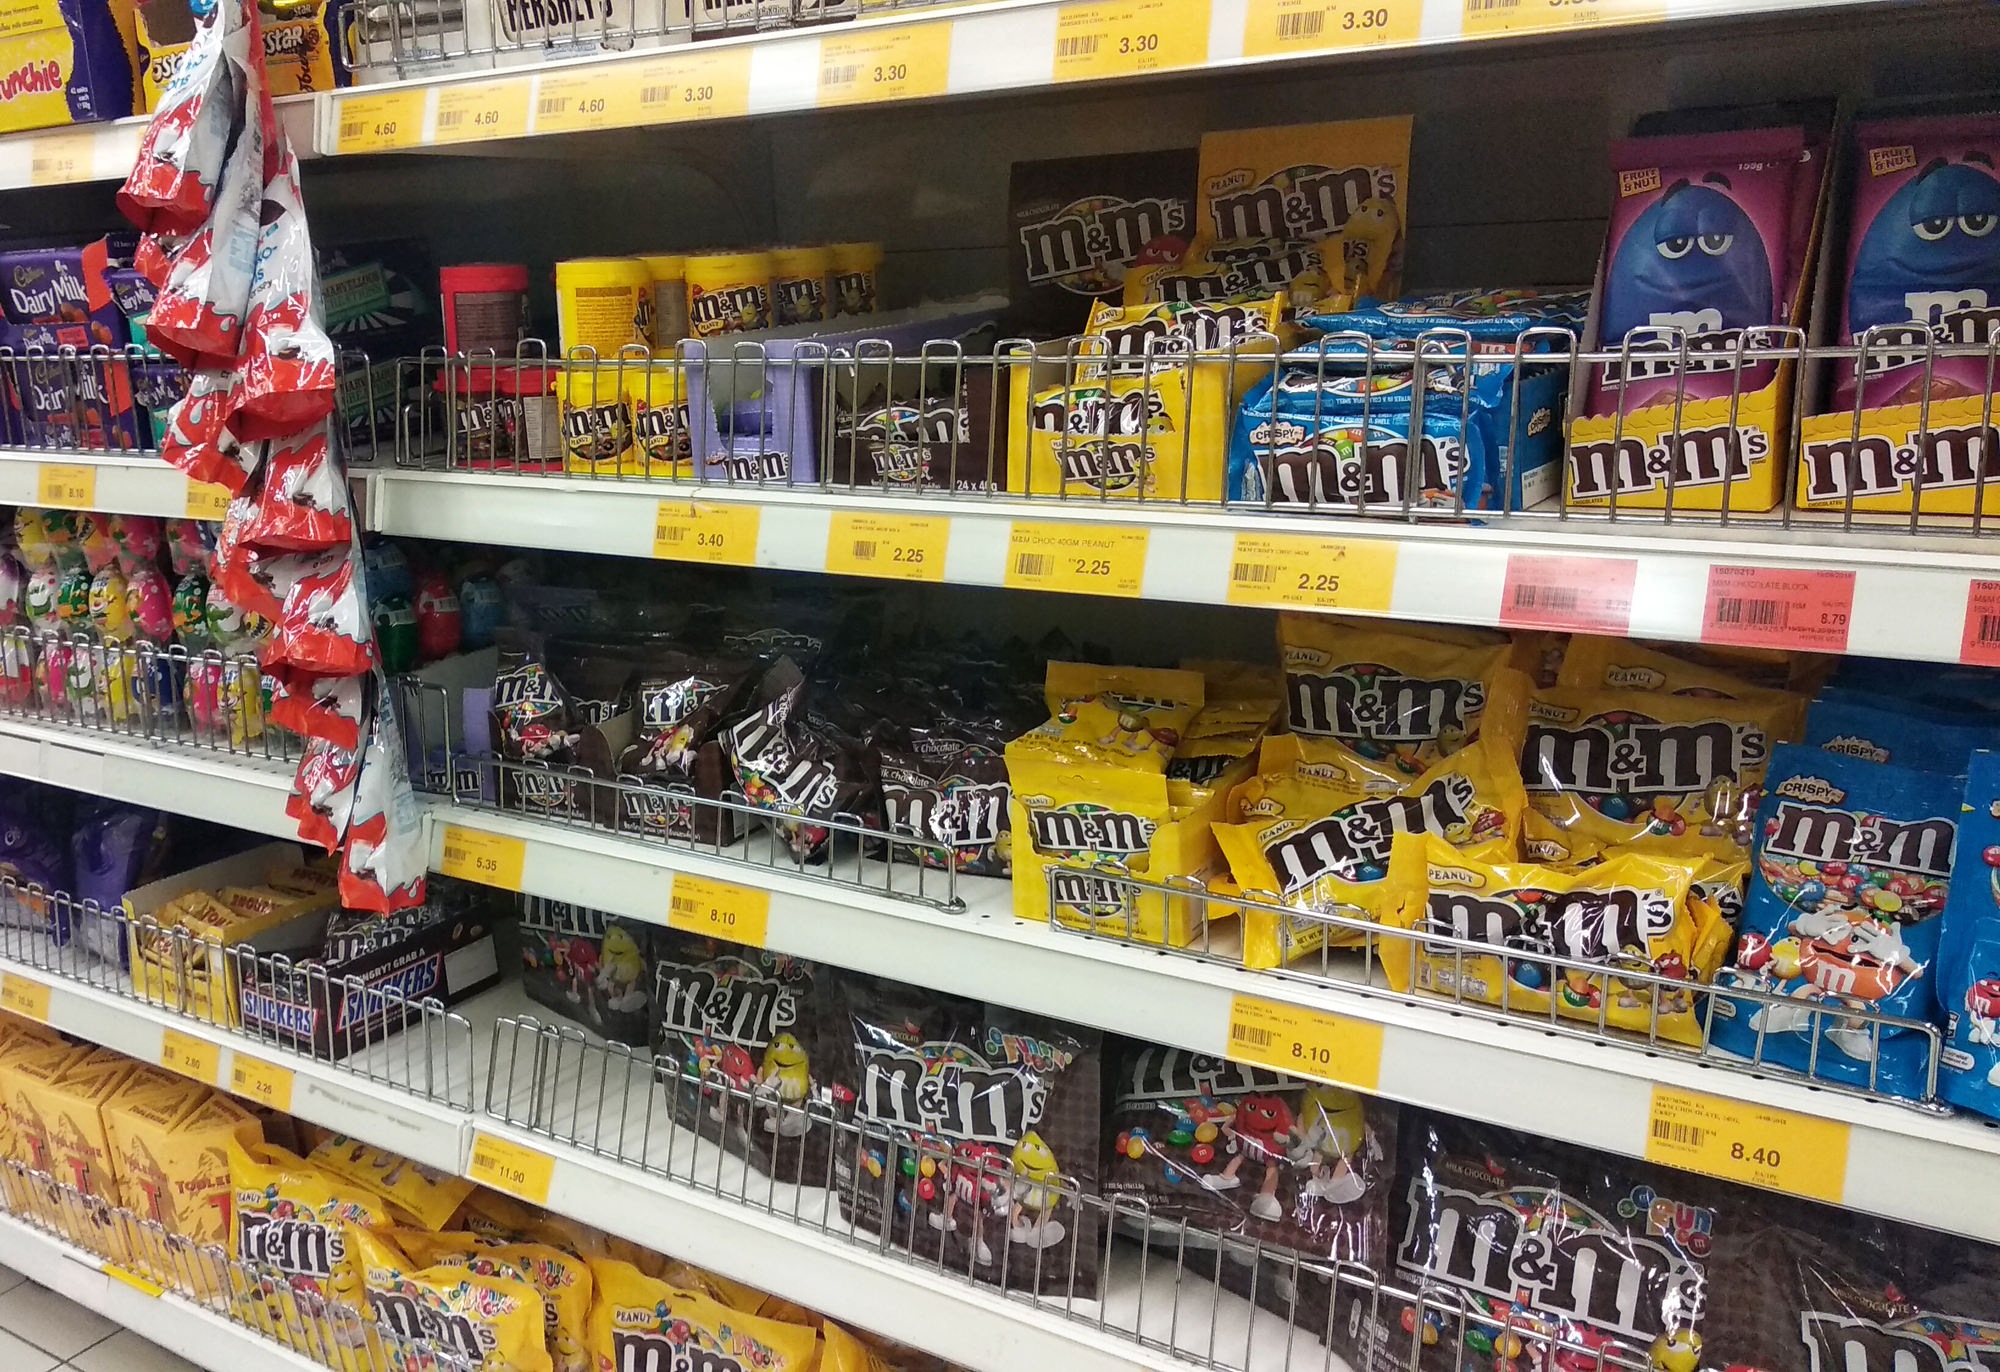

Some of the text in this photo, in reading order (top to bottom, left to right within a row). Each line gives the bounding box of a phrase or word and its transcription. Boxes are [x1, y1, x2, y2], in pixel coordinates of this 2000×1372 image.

[509, 0, 613, 32] HERSHEYS
[1342, 8, 1388, 31] 3.30
[1119, 33, 1158, 54] 3.30
[0, 60, 62, 101] unchie
[873, 63, 907, 83] 3.30
[684, 85, 713, 102] 3.30
[578, 98, 605, 114] 4.60
[474, 110, 499, 126] 4.60
[374, 121, 397, 136] 4.60
[1873, 147, 1913, 162] FRUIT
[1211, 173, 1247, 191] PEANUT
[1622, 169, 1657, 184] FRUIT
[11, 274, 90, 316] Dairy Milk
[1255, 429, 1296, 441] CRSPY
[956, 479, 969, 490] 24
[697, 532, 724, 548] 3.40
[1011, 534, 1031, 545] M&M
[1032, 536, 1056, 546] CHOC
[1082, 539, 1116, 549] PEANUT
[893, 547, 924, 564] 2.25
[1075, 558, 1111, 576] 2.25
[1297, 573, 1340, 592] 2.25
[1734, 581, 1780, 590] CHOCOLATE
[1782, 582, 1810, 591] BLOCK
[1820, 613, 1847, 625] 8.79
[1608, 669, 1652, 685] PEANUT
[1783, 783, 1834, 796] CRISPY
[476, 856, 498, 872] 5.35
[1428, 869, 1475, 884] PEANUT
[710, 908, 736, 926] 8.10
[1291, 1042, 1331, 1065] 8.10
[1730, 1141, 1782, 1169] 8.40
[500, 1165, 525, 1184] 11.90
[1464, 1165, 1506, 1188] CHOCOLATE
[615, 1309, 652, 1324] PEANUT
